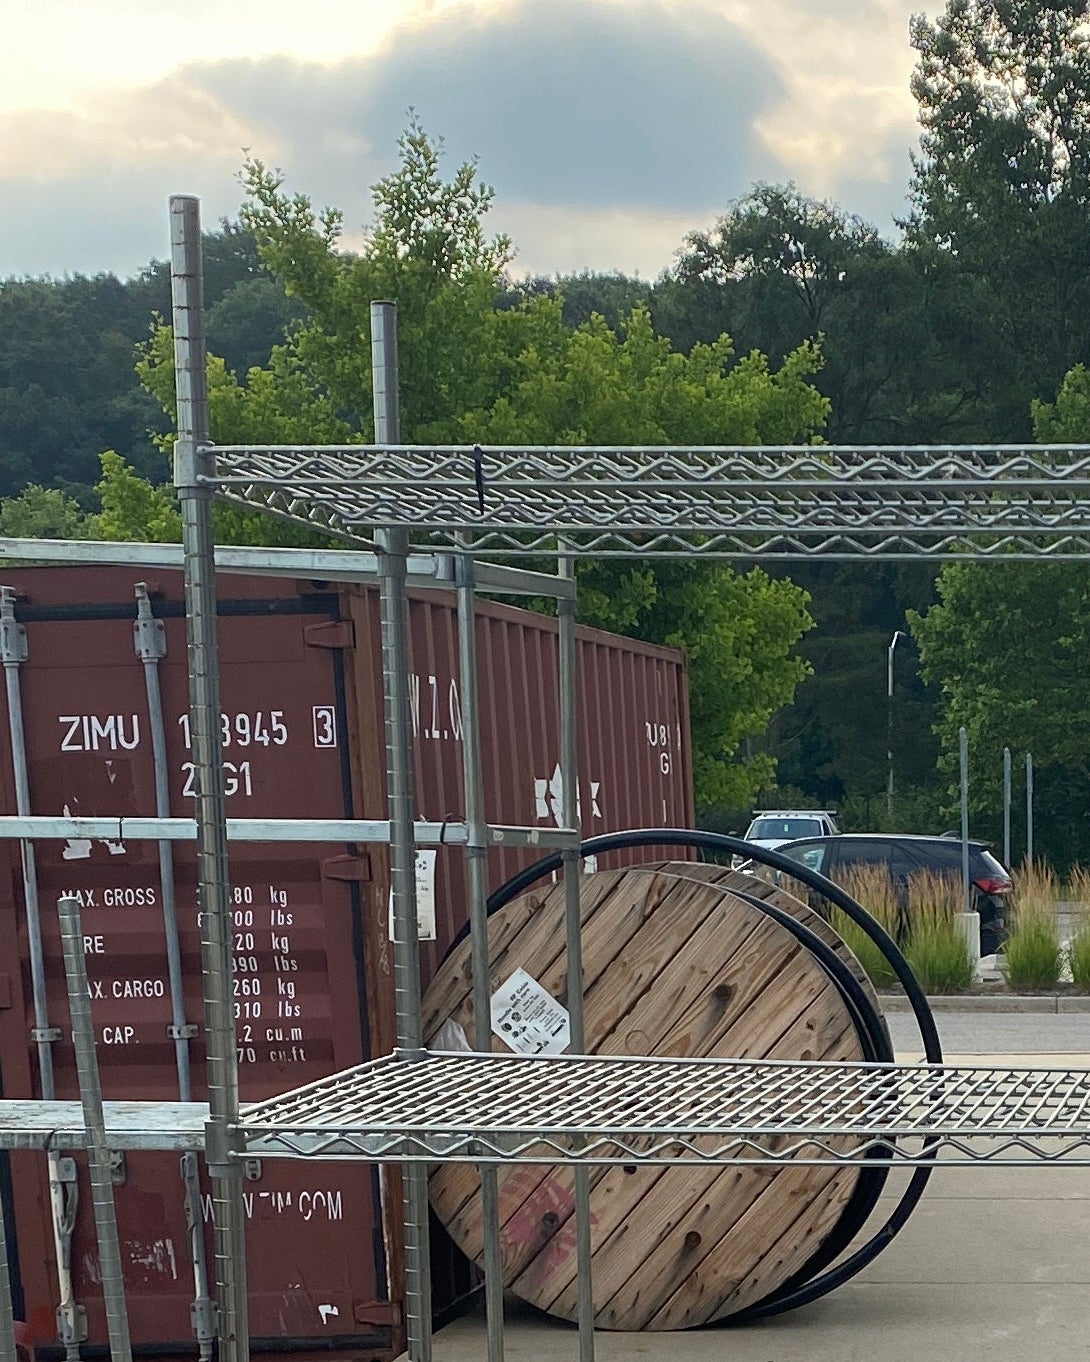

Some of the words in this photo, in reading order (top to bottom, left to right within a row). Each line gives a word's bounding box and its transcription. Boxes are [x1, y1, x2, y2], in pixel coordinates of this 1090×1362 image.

[58, 713, 140, 752] ZIMU
[314, 708, 336, 745] 3
[180, 760, 252, 798] 2G1
[103, 887, 156, 907] GROSS
[269, 885, 288, 908] kg
[270, 910, 293, 926] lbs
[83, 934, 105, 954] RE
[271, 932, 290, 955] kg
[274, 955, 298, 972] lbs
[86, 981, 108, 999] AX.
[112, 980, 164, 998] CARGO
[232, 978, 261, 997] 260
[277, 977, 296, 1000] kg
[277, 1001, 301, 1017] lbs
[103, 1027, 140, 1045] CAP.
[266, 1026, 303, 1042] cu.m
